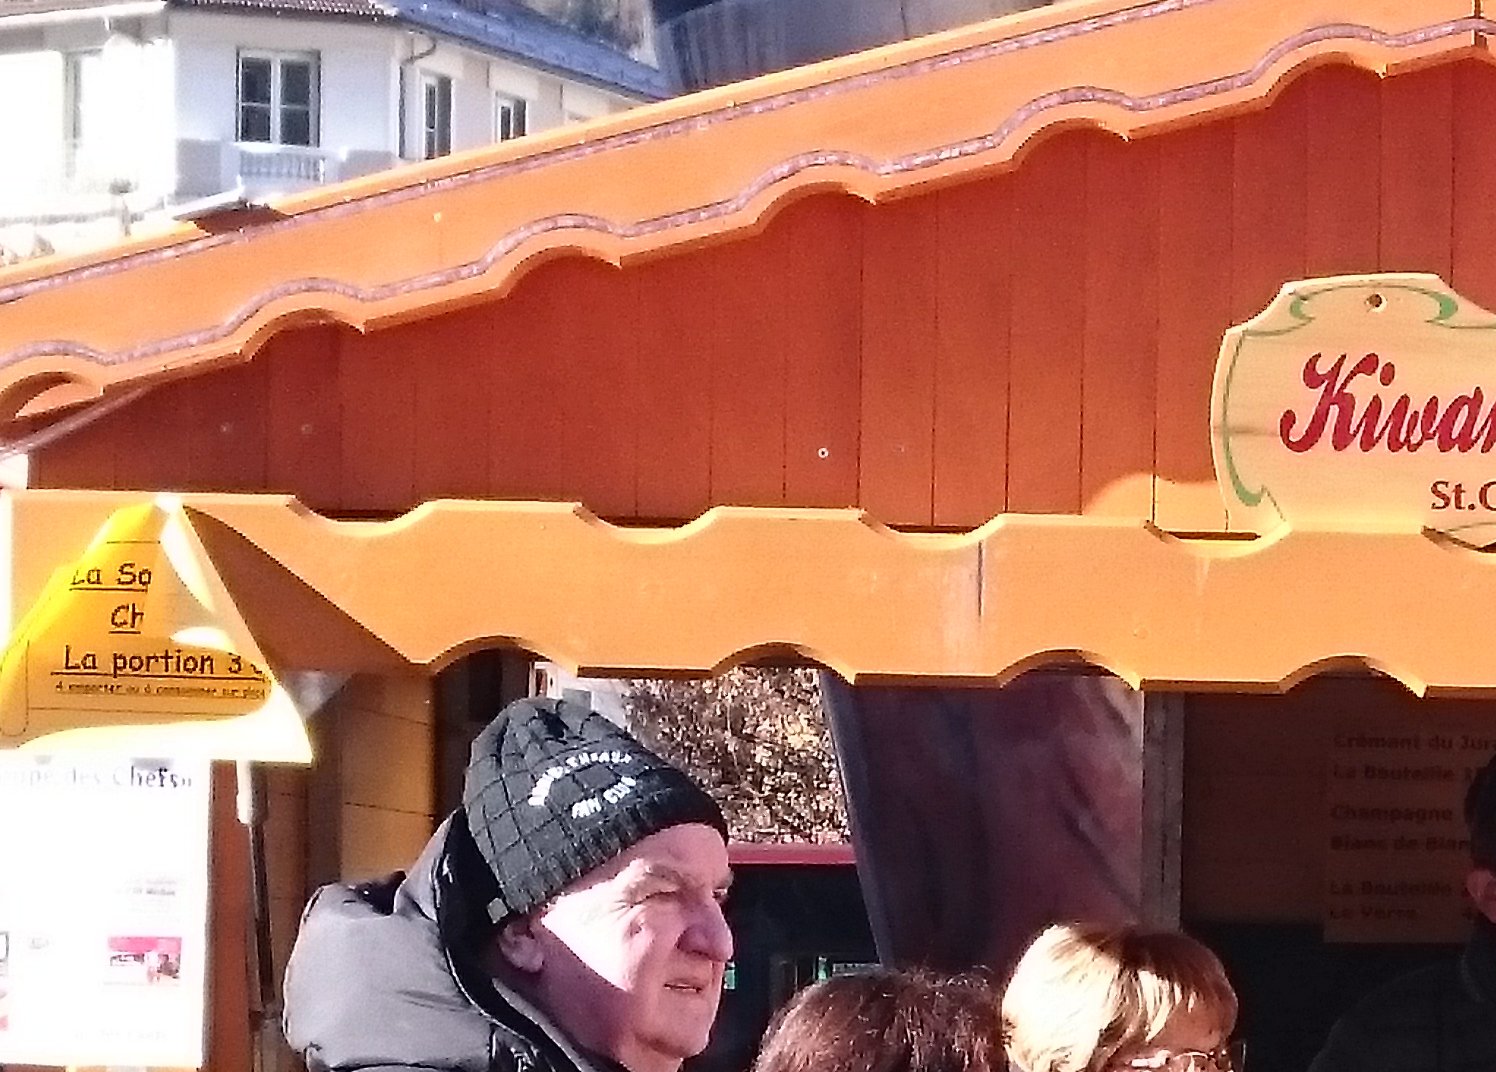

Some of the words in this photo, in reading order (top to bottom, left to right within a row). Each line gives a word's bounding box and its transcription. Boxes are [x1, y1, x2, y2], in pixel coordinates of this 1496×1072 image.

[70, 568, 103, 586] La
[65, 645, 98, 671] La
[112, 649, 214, 678] portion
